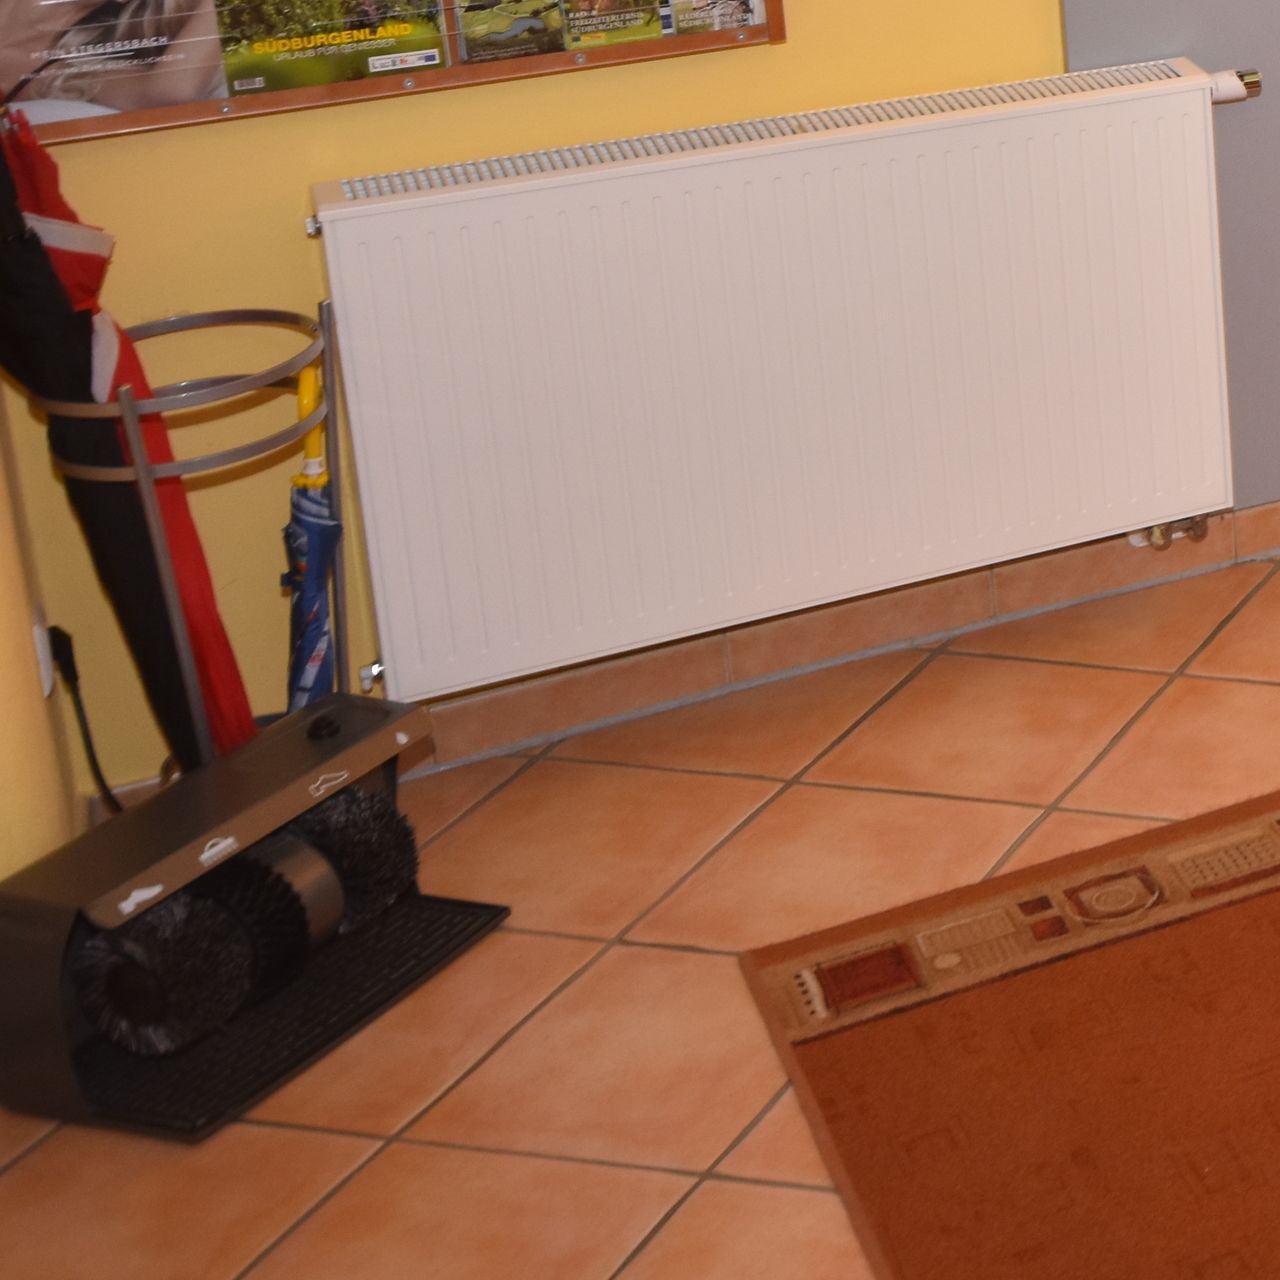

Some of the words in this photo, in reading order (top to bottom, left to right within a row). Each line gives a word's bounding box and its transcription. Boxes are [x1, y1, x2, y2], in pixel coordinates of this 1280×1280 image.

[70, 35, 169, 54] STEGERSBACH
[252, 22, 413, 55] SÜDBURGENLAND
[273, 48, 316, 62] URLAUB
[316, 45, 339, 57] FÜR
